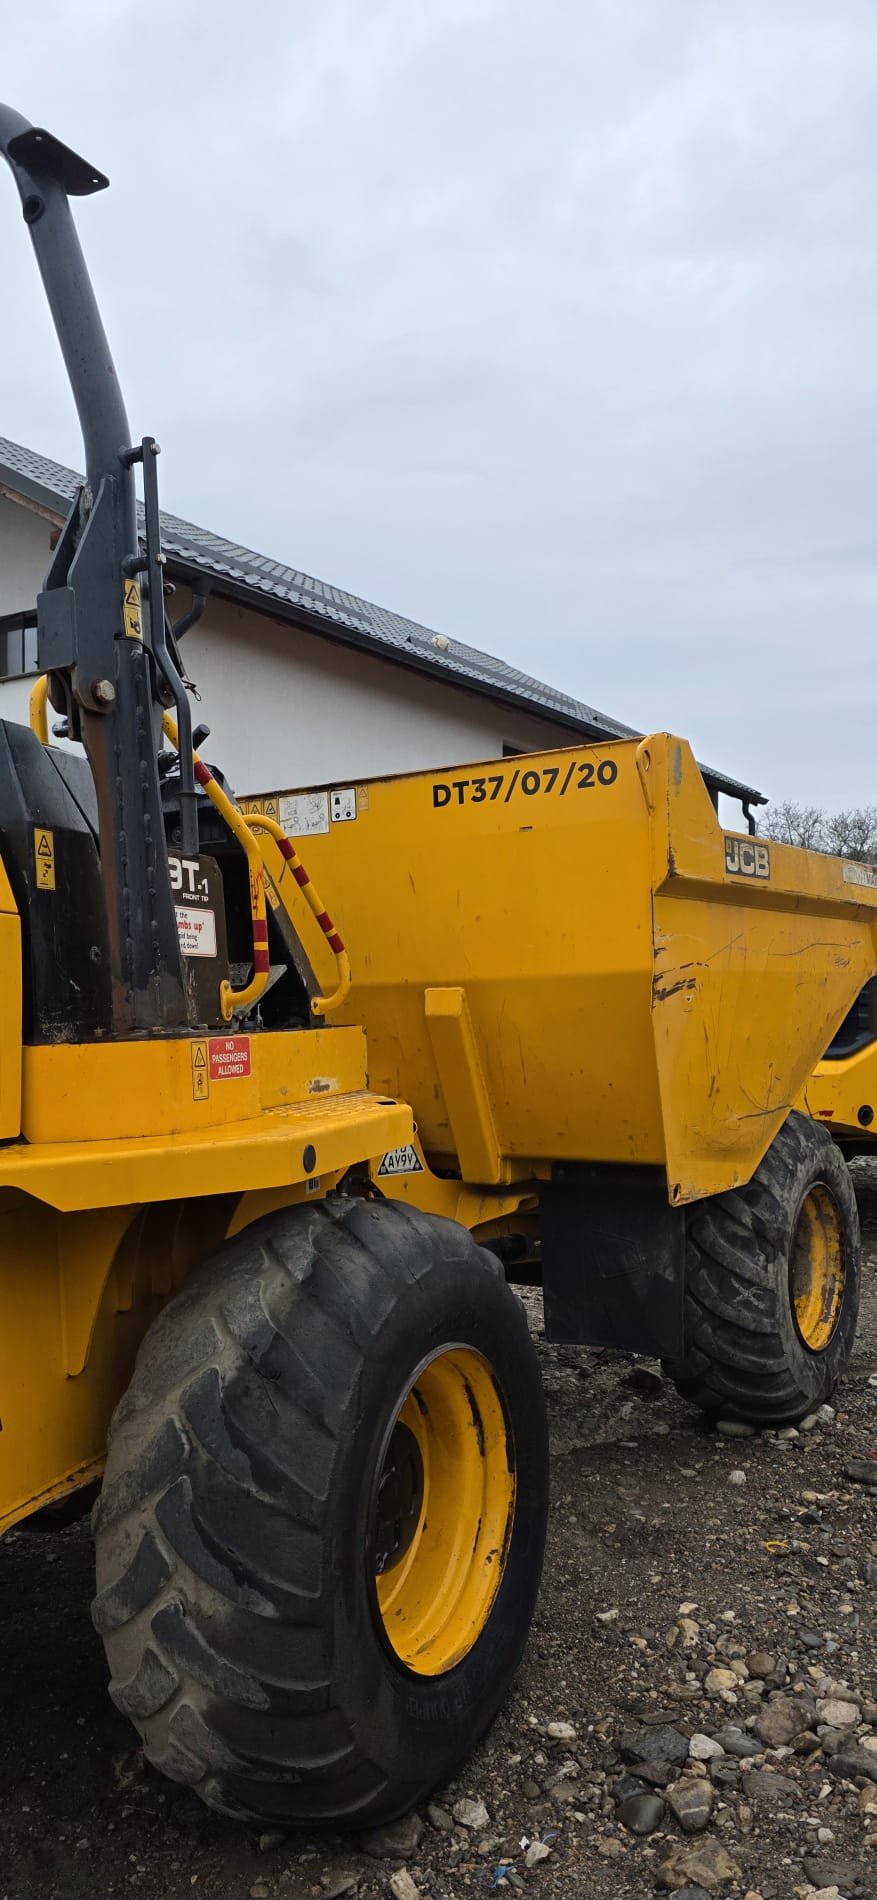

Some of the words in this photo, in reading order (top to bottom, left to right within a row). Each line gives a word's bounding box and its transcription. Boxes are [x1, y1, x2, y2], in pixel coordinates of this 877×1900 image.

[432, 759, 618, 808] DT37/07/20
[726, 839, 770, 877] JCB
[182, 892, 200, 901] FRONT
[225, 1041, 234, 1051] NO
[212, 1051, 248, 1064] PASSENGERS
[218, 1064, 244, 1075] ALLOWED
